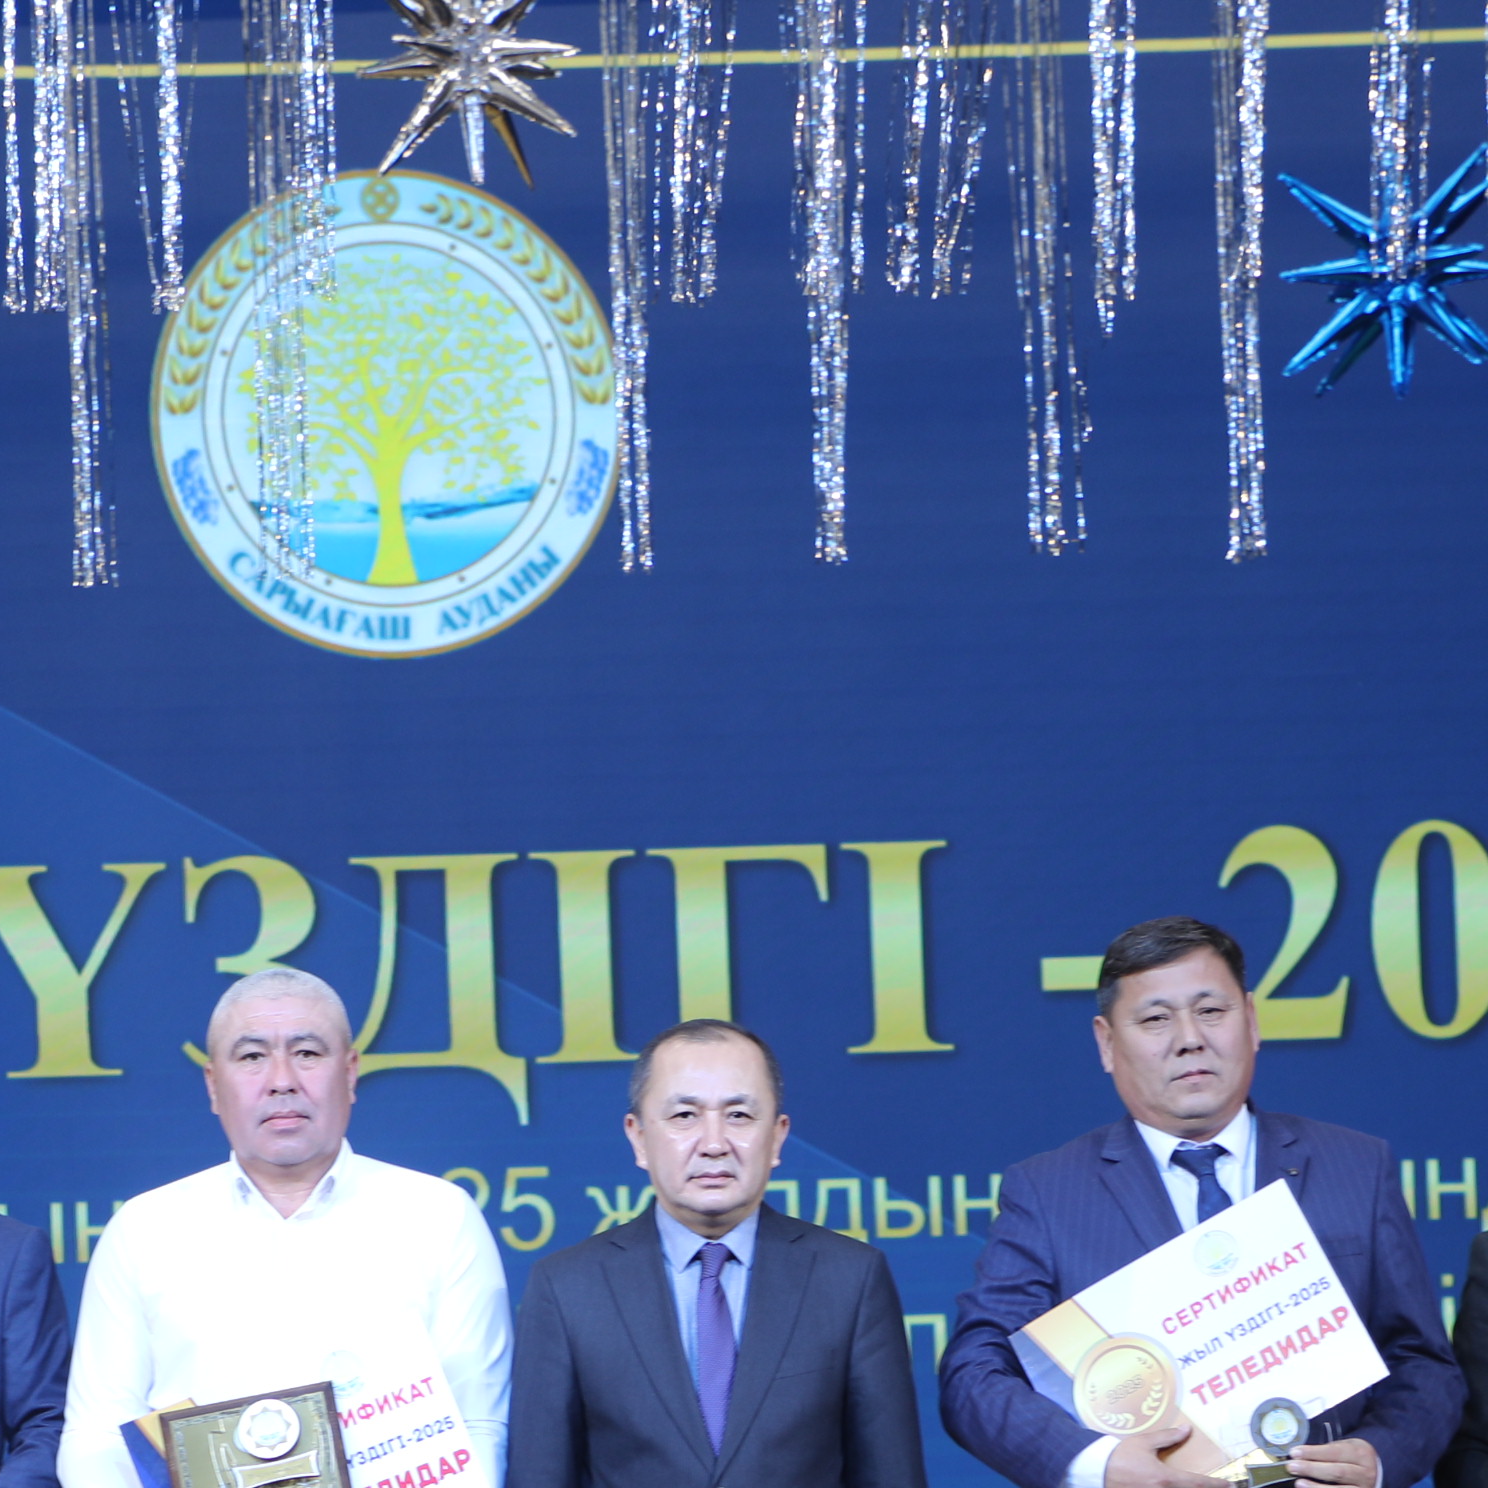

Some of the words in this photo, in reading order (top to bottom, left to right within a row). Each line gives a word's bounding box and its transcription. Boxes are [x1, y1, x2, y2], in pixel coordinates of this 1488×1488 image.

[436, 545, 561, 636] АУДАНЫ
[1161, 1242, 1308, 1335] СЕРТИФИКАТ
[1176, 1337, 1225, 1370] ЖЫЛ
[1190, 1305, 1349, 1405] ТЕЛЕДИДАР
[337, 1376, 434, 1429] ИФИКАТ
